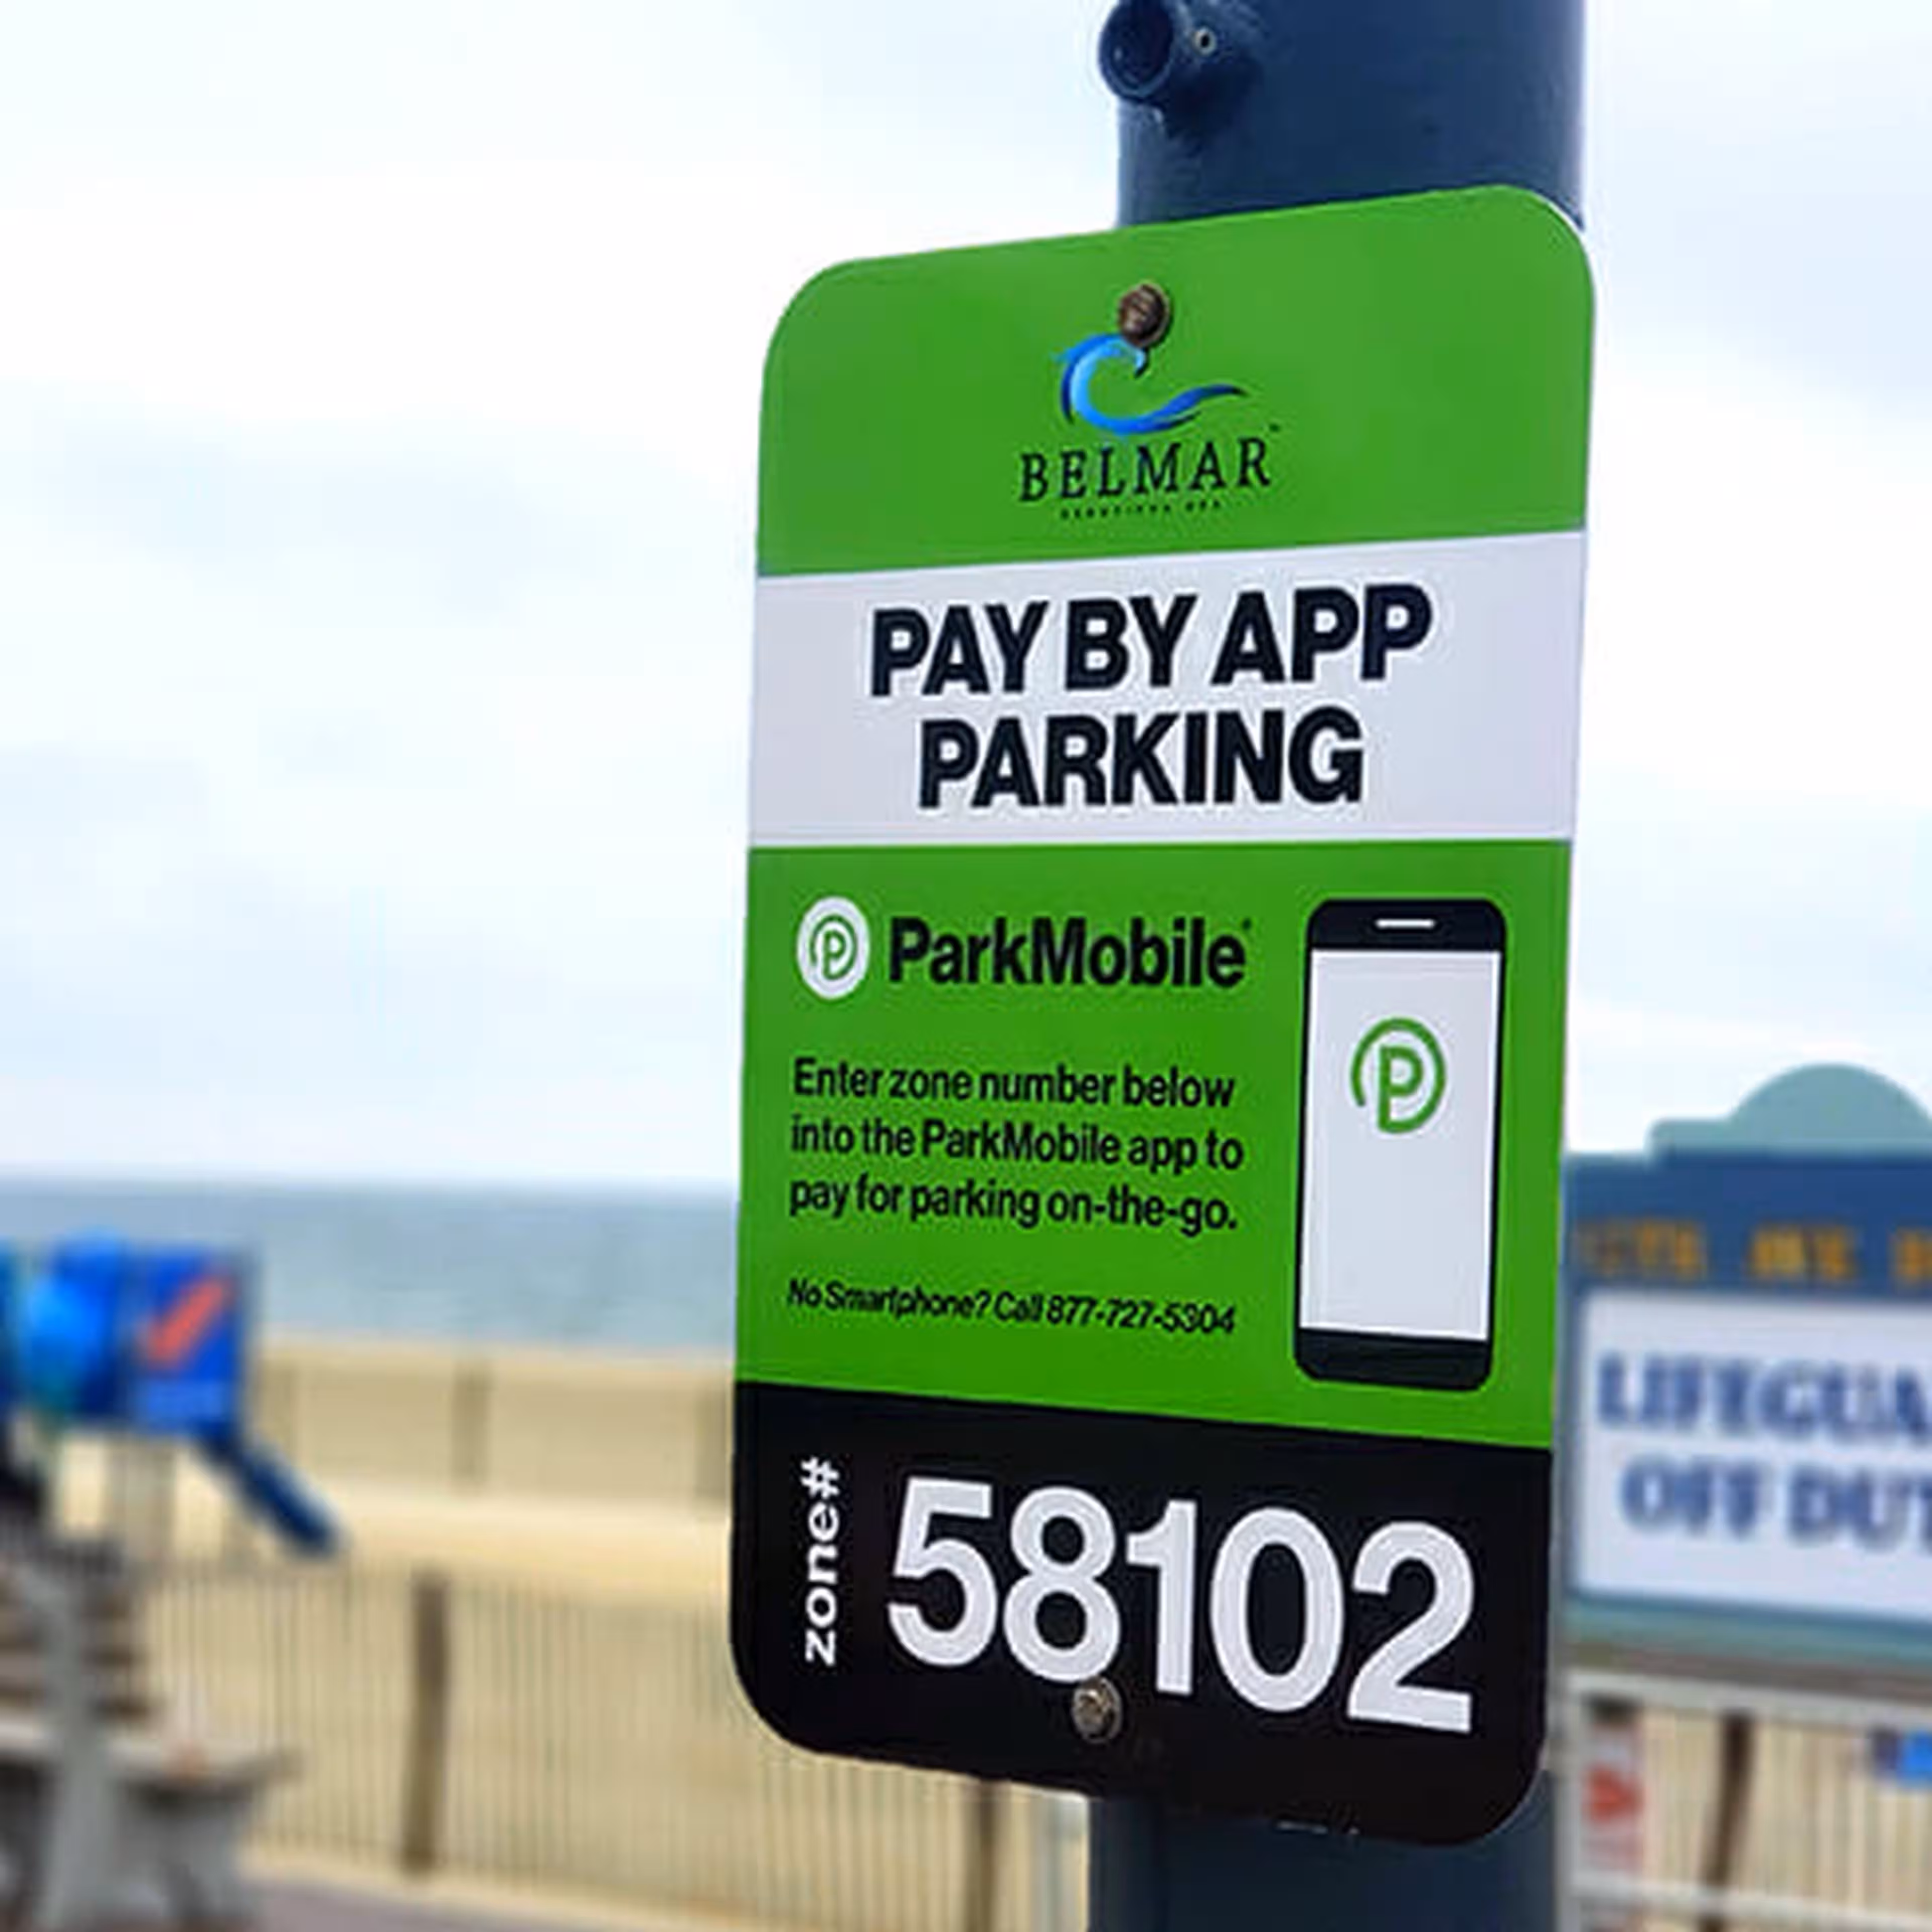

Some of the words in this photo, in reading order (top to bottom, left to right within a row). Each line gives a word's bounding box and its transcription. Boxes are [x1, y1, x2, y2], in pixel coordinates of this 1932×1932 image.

[1018, 436, 1271, 502] BELMAR
[870, 600, 1050, 696] PAY
[1065, 594, 1198, 691] BY
[1211, 583, 1433, 685] APP
[919, 705, 1364, 808] PARKING
[890, 916, 1247, 988] ParkMobile
[793, 1056, 882, 1098] Enter
[889, 1067, 973, 1101] zone
[979, 1063, 1116, 1106] number
[1123, 1064, 1235, 1108] below
[791, 1115, 855, 1154] into
[862, 1117, 916, 1157] the
[922, 1118, 1122, 1165] ParkMobile
[1127, 1134, 1198, 1176] app
[1208, 1129, 1245, 1170] to
[789, 1179, 849, 1220] pay
[856, 1173, 904, 1215] for
[910, 1178, 1041, 1229] parking
[1046, 1184, 1239, 1239] on-the-go.
[788, 1278, 821, 1307] No
[825, 1280, 992, 1321] Smartphone?
[994, 1290, 1043, 1323] Call
[1046, 1294, 1236, 1334] 877-727-5304
[802, 1456, 841, 1666] zone#
[888, 1476, 1476, 1734] 58102
